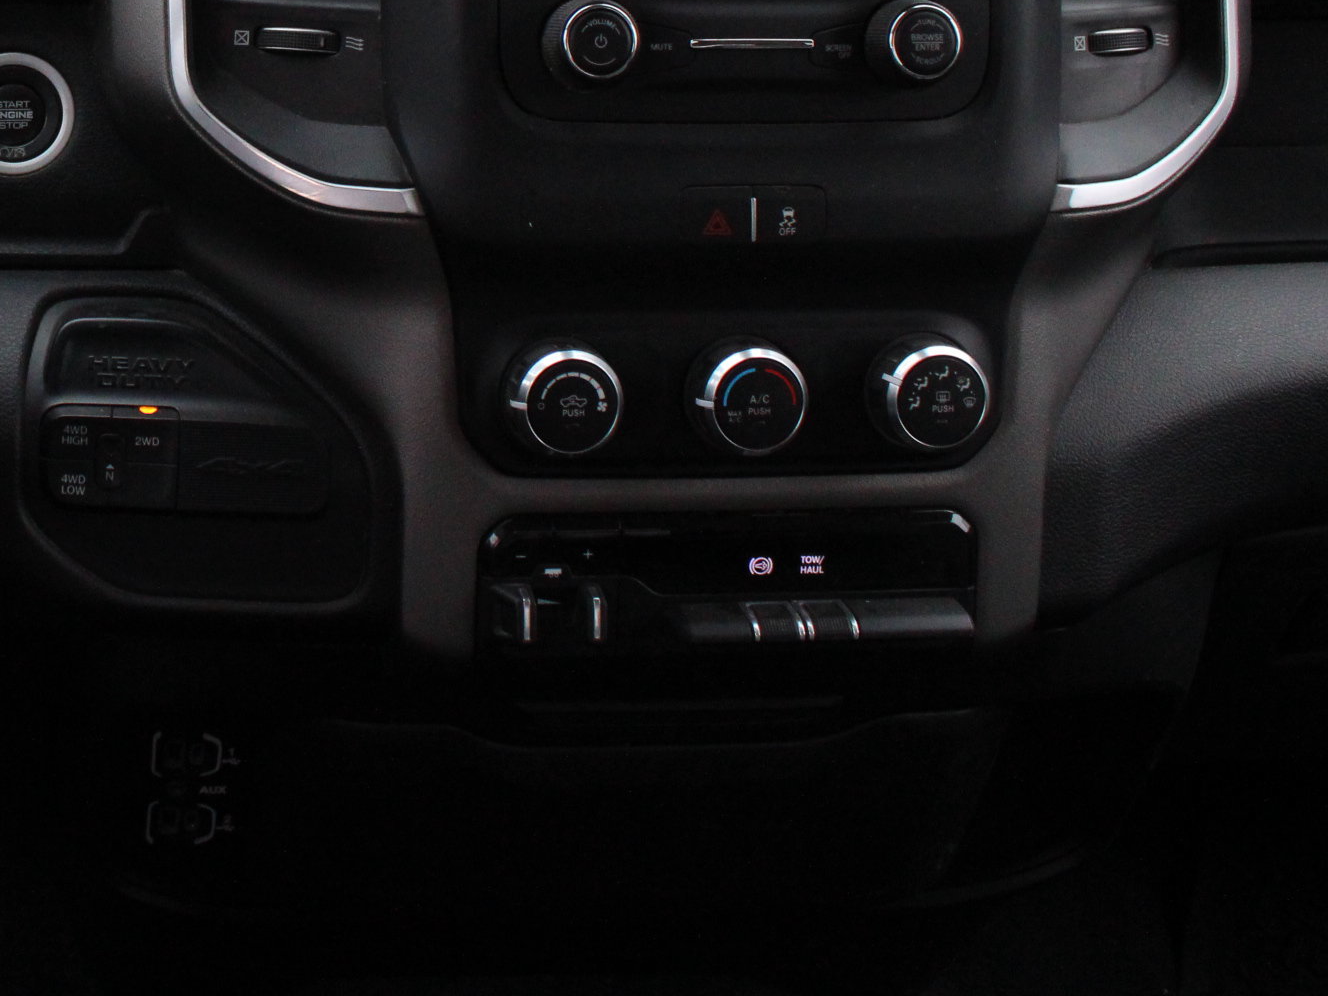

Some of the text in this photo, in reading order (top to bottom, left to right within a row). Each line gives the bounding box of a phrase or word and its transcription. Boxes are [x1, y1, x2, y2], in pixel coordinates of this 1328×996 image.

[587, 19, 616, 29] VOLUME
[911, 33, 944, 41] BROWSE
[779, 227, 796, 236] OFF
[88, 356, 194, 372] HEAVY
[96, 372, 188, 387] DUTY
[749, 394, 771, 404] A/C
[562, 409, 585, 417] PUSH
[748, 407, 771, 416] PUSH
[932, 404, 954, 413] PUSH
[63, 425, 88, 435] 4WD
[61, 435, 88, 446] HIGH
[135, 436, 160, 447] 2WD
[60, 474, 86, 484] 4WD
[105, 470, 114, 481] N
[61, 485, 85, 496] LOW
[800, 554, 825, 565] TOW/
[800, 565, 824, 575] HAUL
[199, 786, 228, 794] AUX
